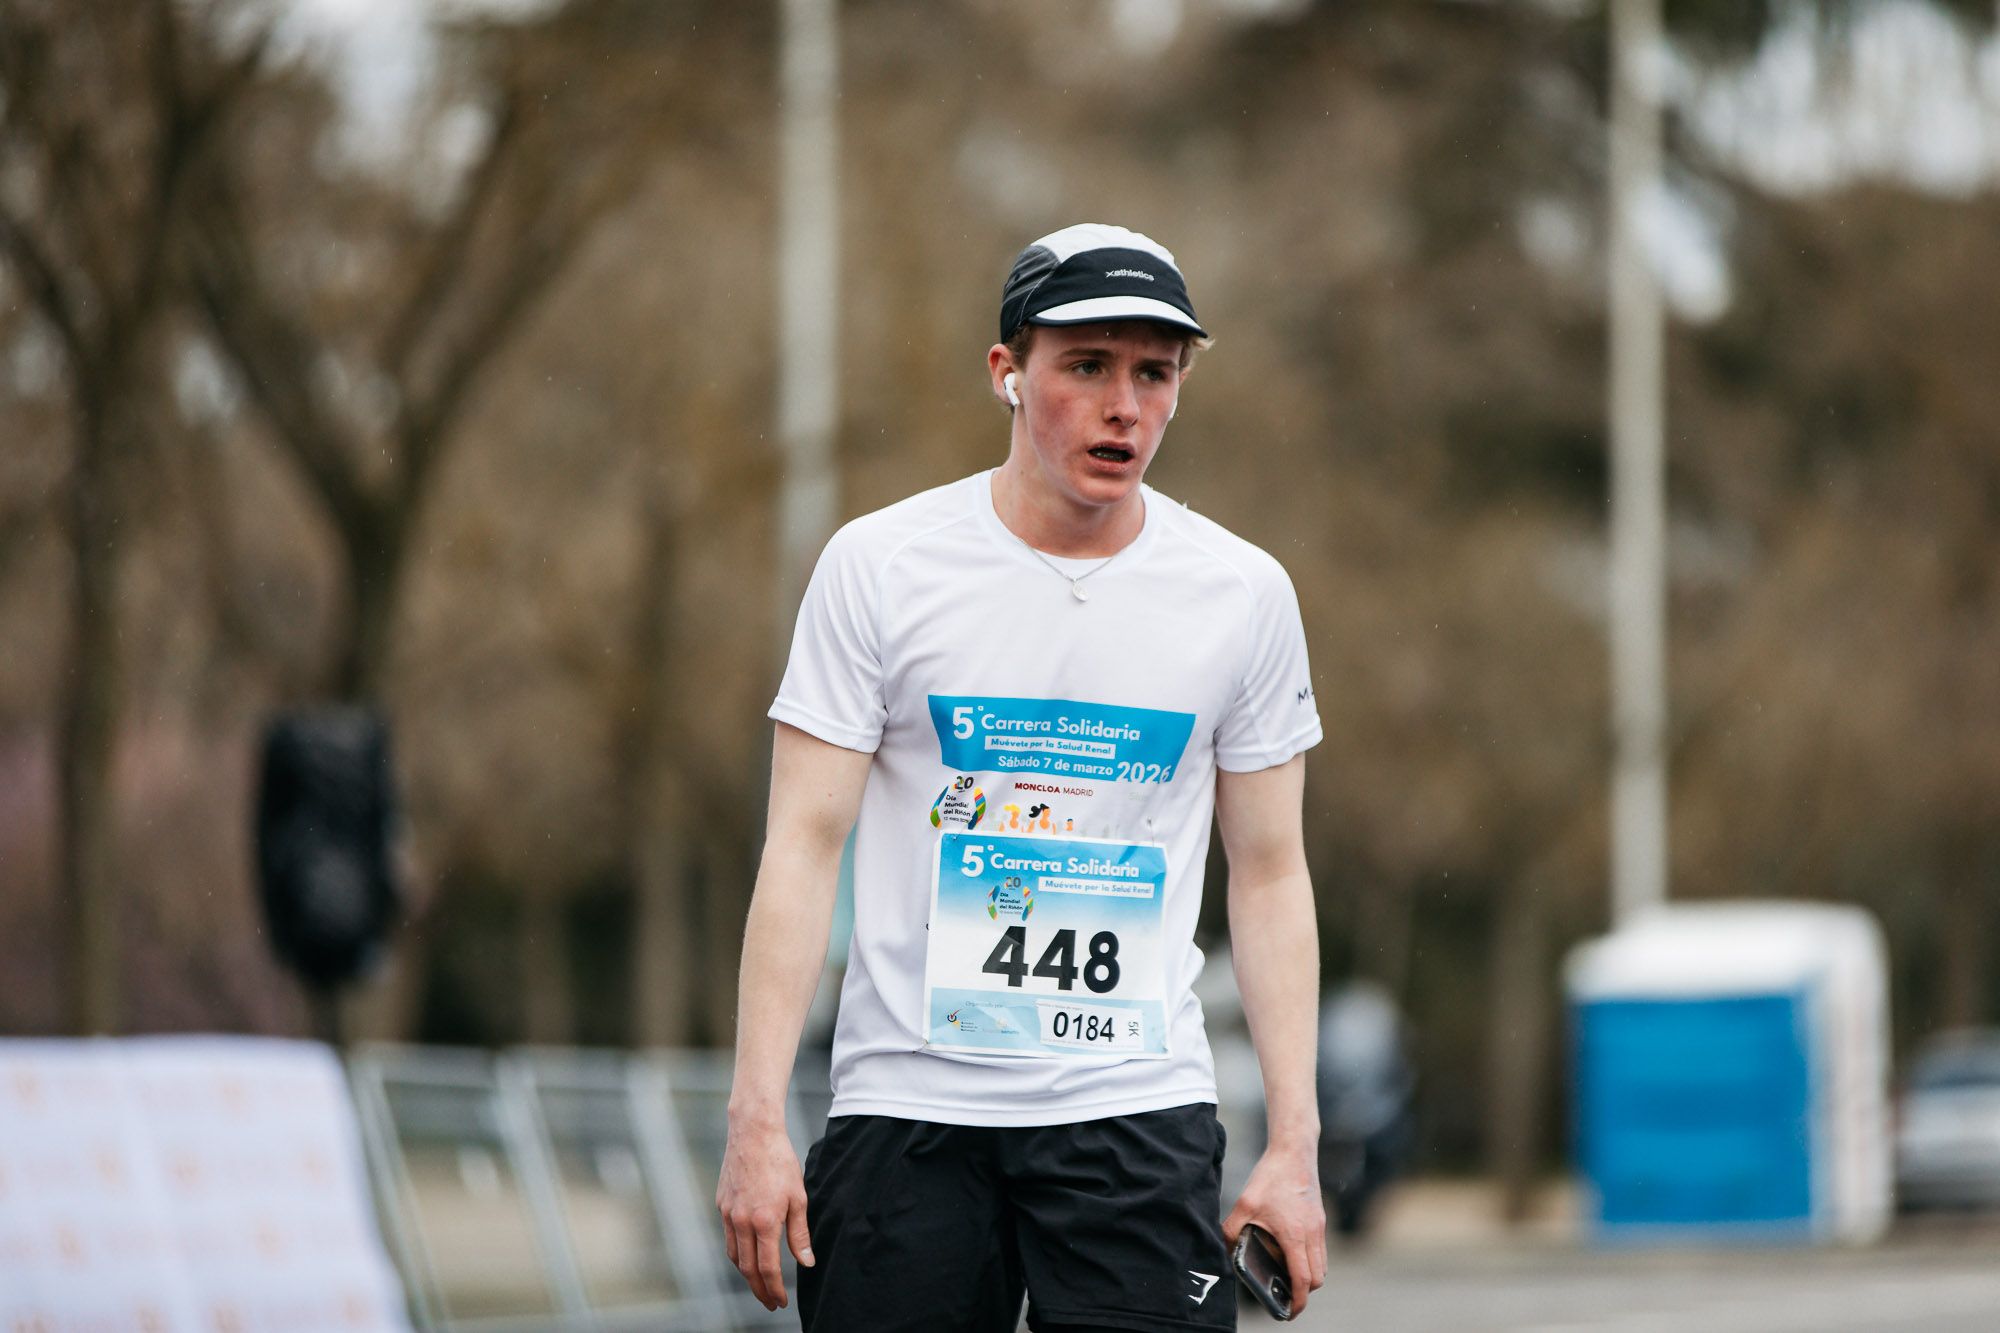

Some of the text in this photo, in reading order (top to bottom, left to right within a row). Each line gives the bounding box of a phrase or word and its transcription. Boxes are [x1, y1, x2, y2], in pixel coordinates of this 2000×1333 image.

[981, 713, 1051, 732] Carrera
[1057, 716, 1141, 741] Solidaria
[991, 738, 1111, 755] Muévete por la Salud Renal
[998, 755, 1172, 784] Sábado 7 de marzo 2026
[1014, 782, 1094, 797] MONCLOA MADRID
[990, 853, 1062, 873] Carrera
[1067, 857, 1140, 878] Solidaria
[1045, 880, 1082, 890] Muévete
[1085, 884, 1098, 892] por
[982, 925, 1120, 994] 448
[1053, 1011, 1115, 1042] 0184
[1128, 1021, 1140, 1037] 5K
